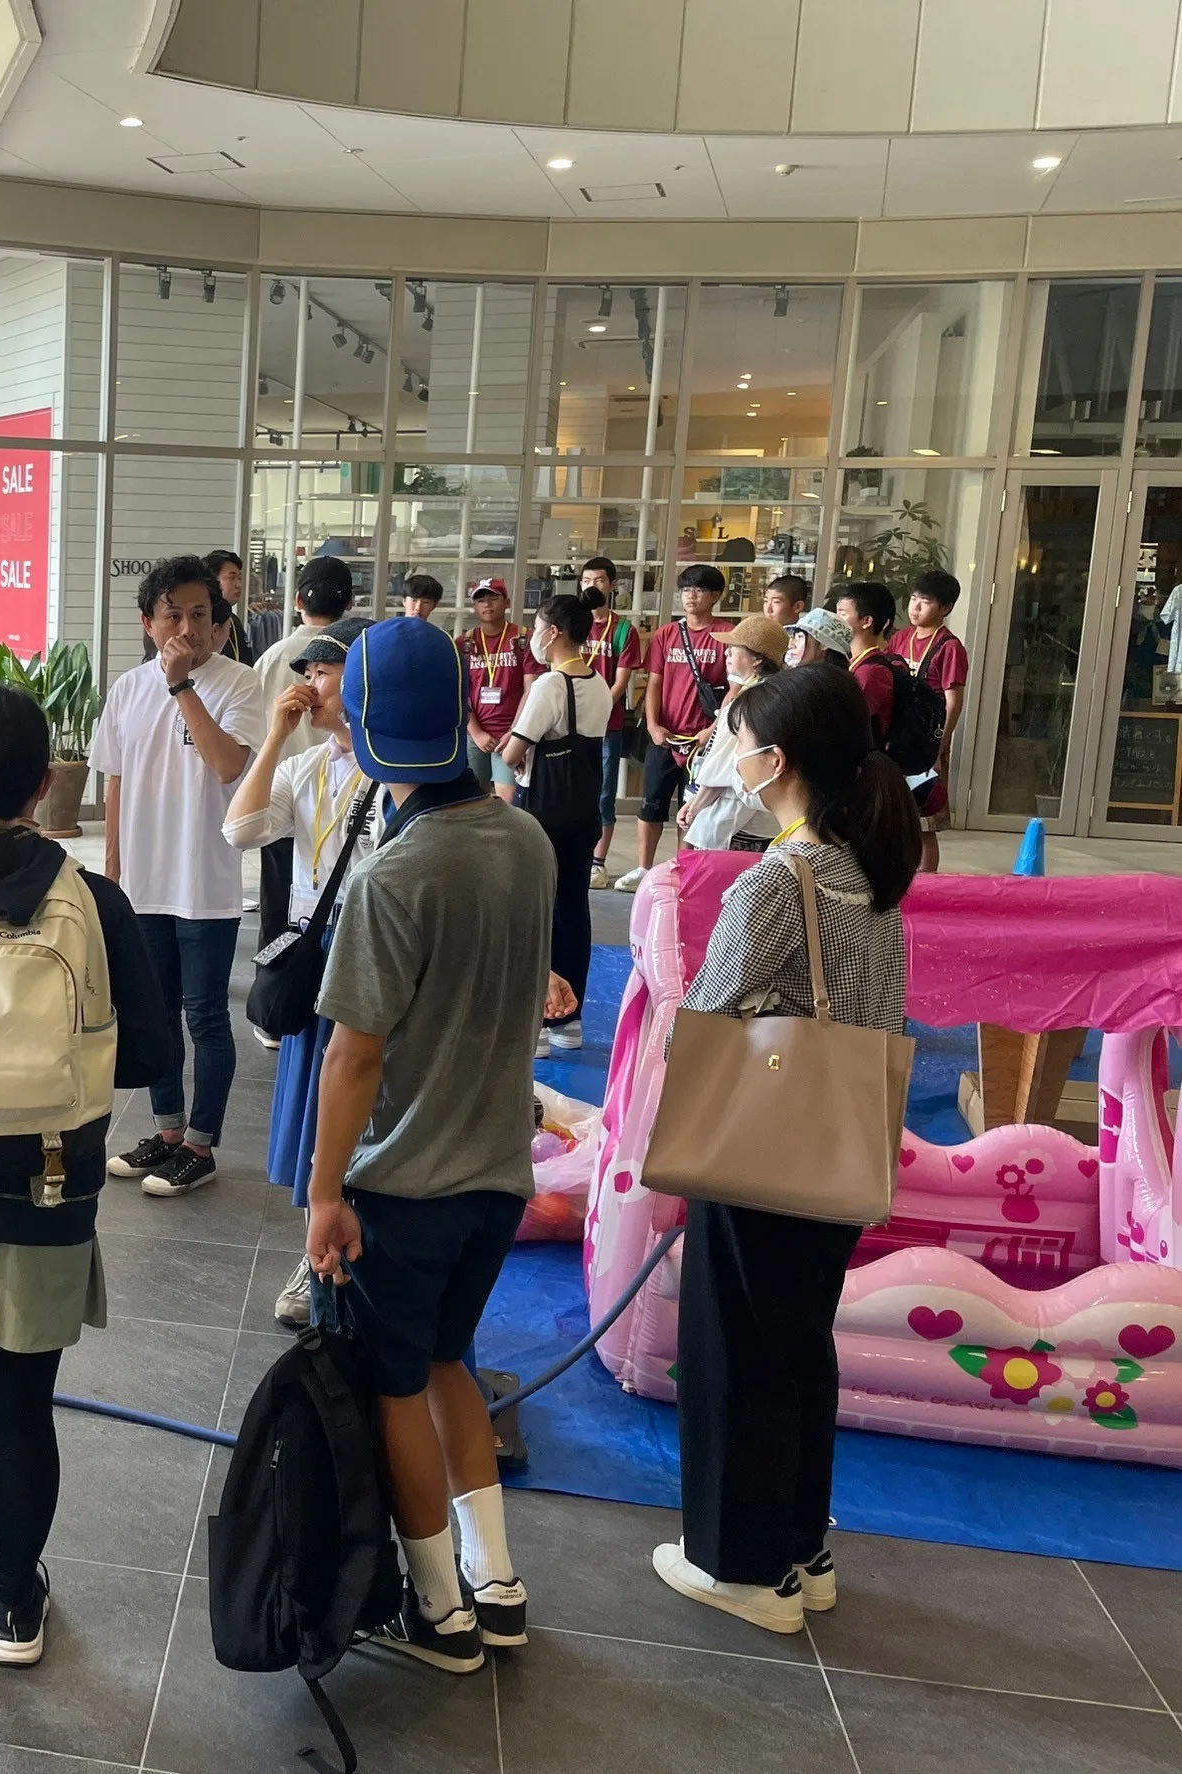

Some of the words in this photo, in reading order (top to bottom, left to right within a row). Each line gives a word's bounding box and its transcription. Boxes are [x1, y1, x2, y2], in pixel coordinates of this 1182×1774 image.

[2, 463, 34, 495] SALE
[0, 559, 32, 589] SALE
[110, 559, 152, 578] SHOO
[0, 929, 41, 939] Columbia
[851, 1384, 923, 1402] PEARL
[930, 1395, 1007, 1412] BEACH
